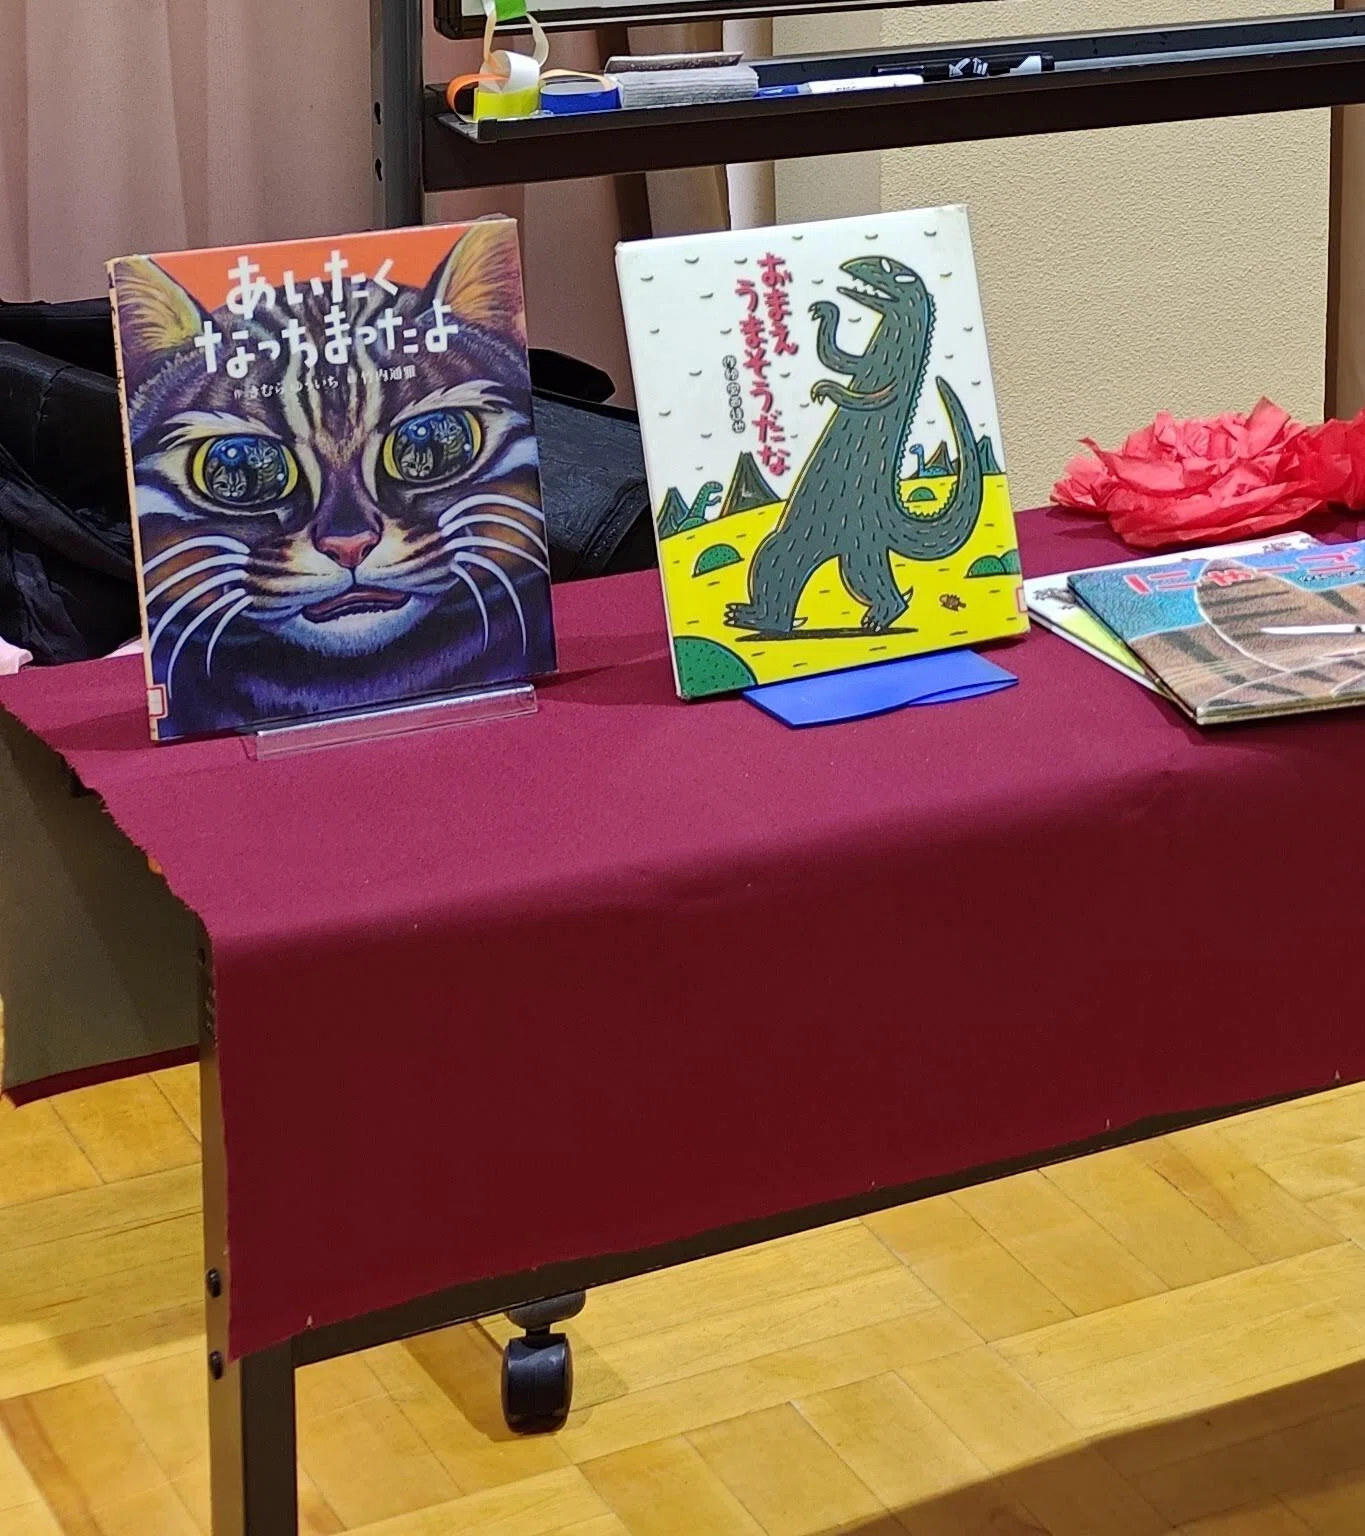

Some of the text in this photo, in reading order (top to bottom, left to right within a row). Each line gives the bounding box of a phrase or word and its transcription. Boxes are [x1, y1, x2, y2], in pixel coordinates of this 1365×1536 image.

[225, 249, 400, 321] あいたく
[757, 252, 799, 357] おまえ
[193, 298, 460, 380] なっちまったよ
[735, 279, 792, 477] うまそうだな
